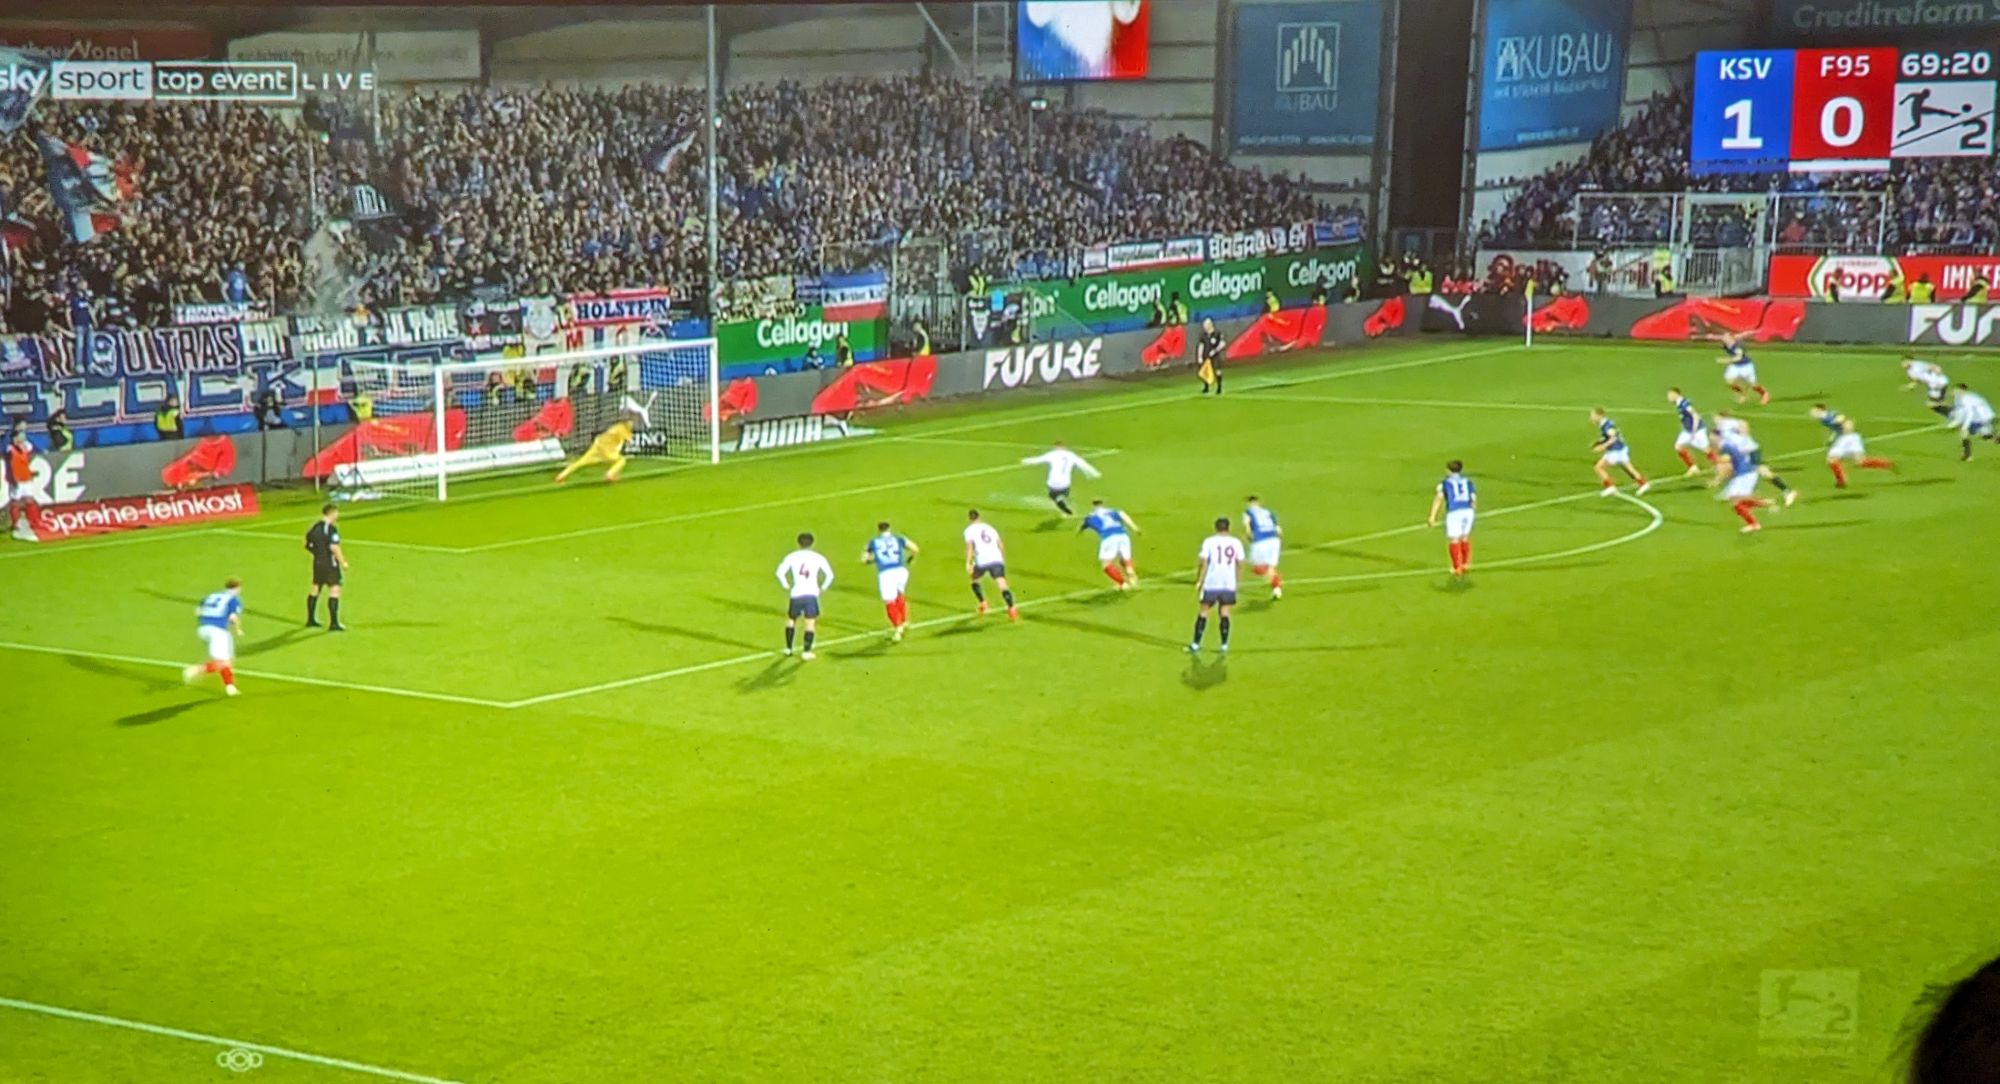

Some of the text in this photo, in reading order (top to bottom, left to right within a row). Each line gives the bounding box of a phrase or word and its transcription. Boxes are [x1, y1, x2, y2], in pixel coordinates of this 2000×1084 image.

[1793, 1, 1985, 28] Creditreform
[1084, 281, 1161, 311] Cellagon
[1190, 270, 1262, 300] Cellagon
[577, 298, 668, 319] HOLSTEIN
[757, 314, 849, 348] Cellagon
[119, 325, 243, 376] ULTRAS
[983, 337, 1102, 389] FUTURE
[742, 416, 823, 450] PUMA
[41, 489, 244, 534] Sprehe-feinkost
[980, 529, 992, 544] 6
[1216, 544, 1235, 566] 19
[799, 563, 811, 579] 4
